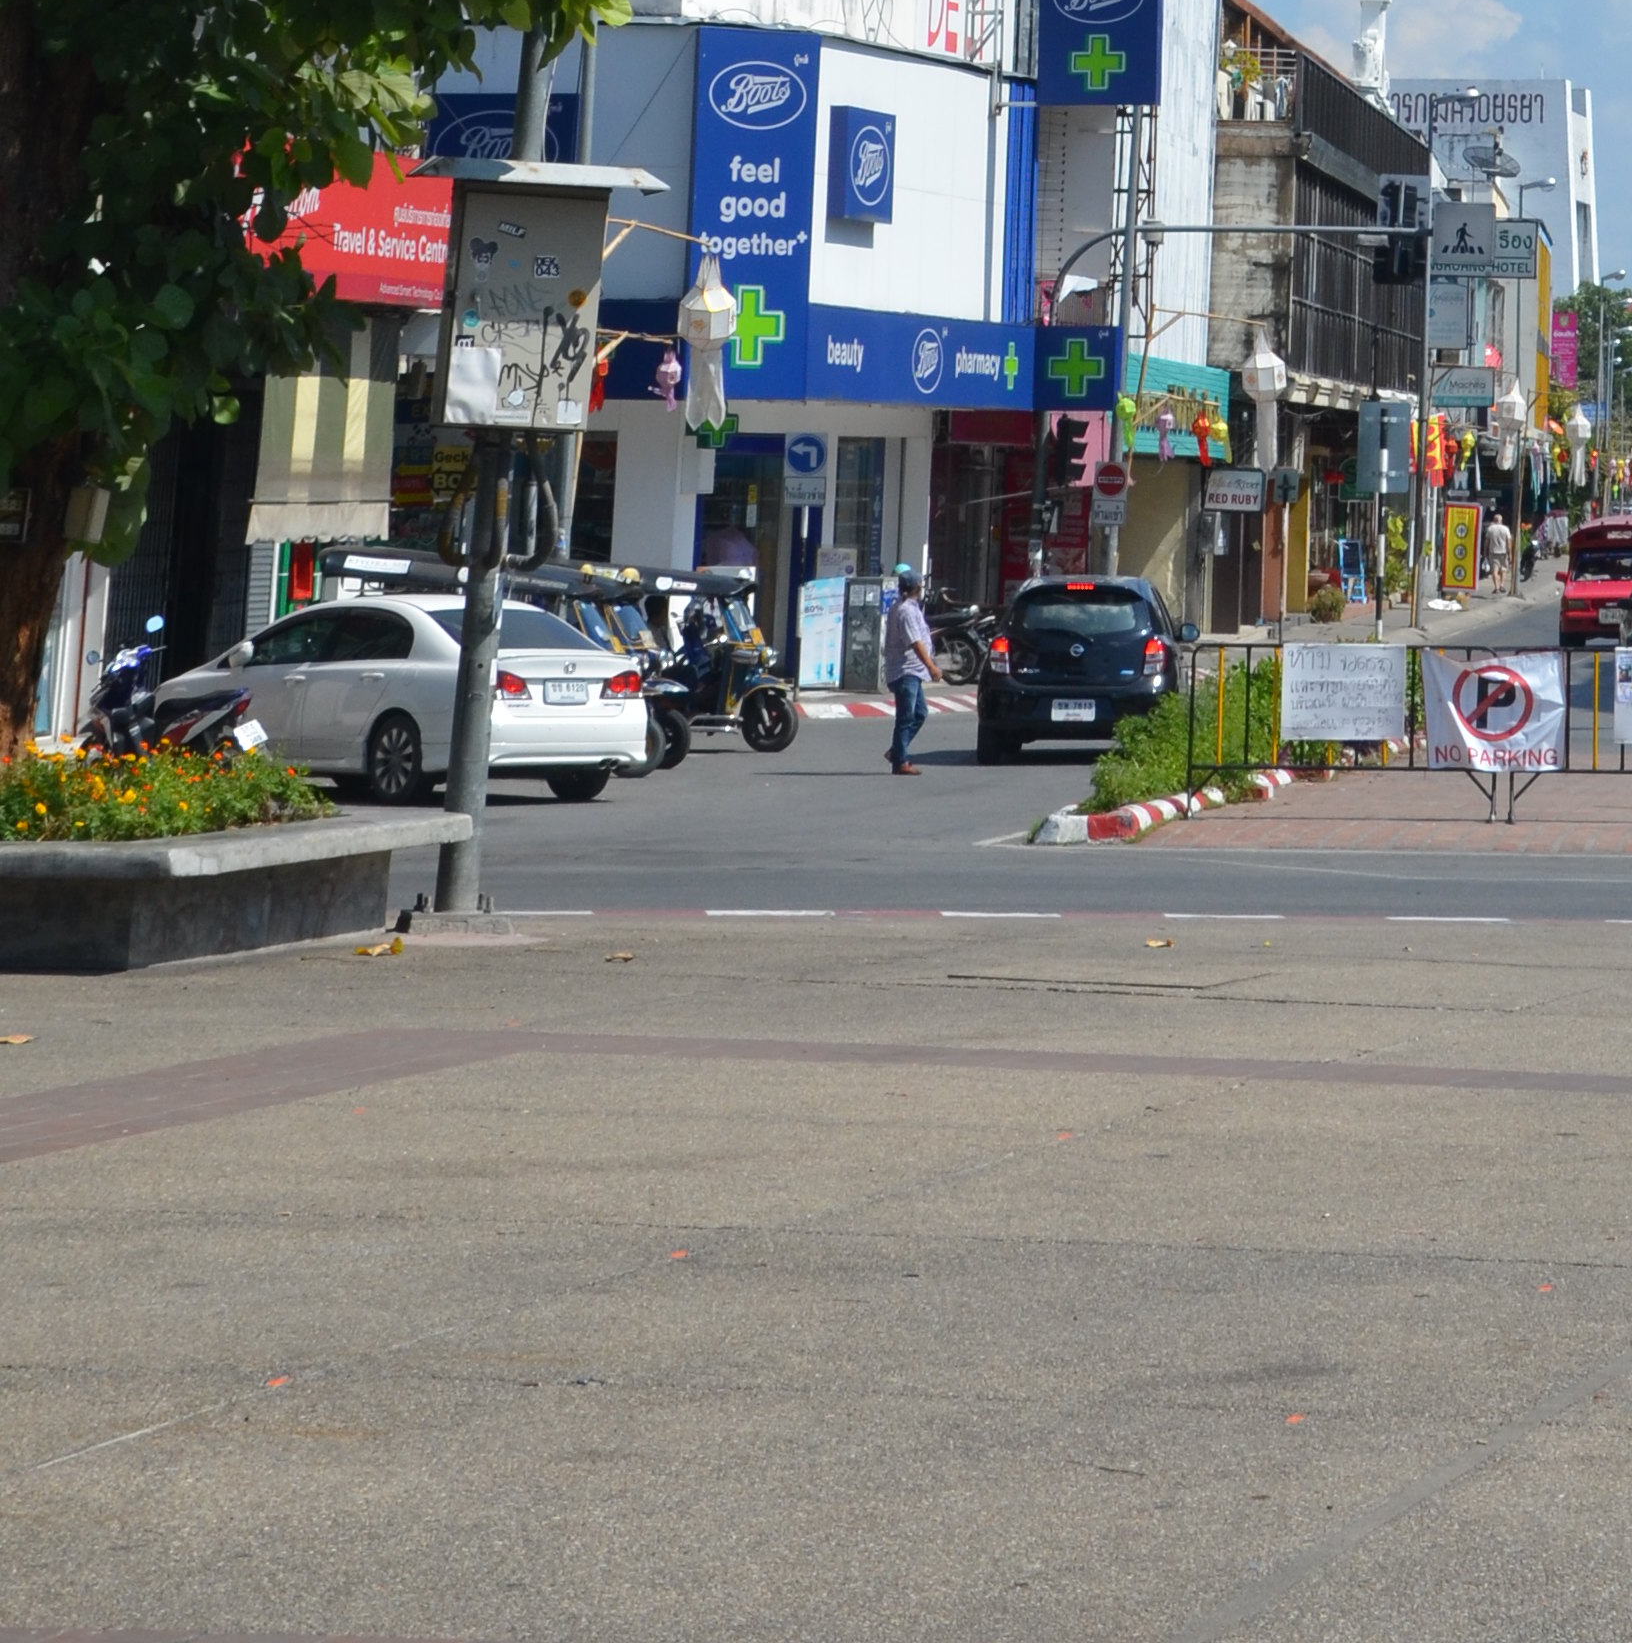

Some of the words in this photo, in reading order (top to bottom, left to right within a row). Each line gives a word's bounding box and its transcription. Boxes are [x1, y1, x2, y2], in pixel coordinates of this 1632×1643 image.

[720, 73, 791, 115] Boots
[729, 155, 781, 184] feel
[719, 191, 787, 223] good
[333, 222, 367, 256] Travel
[367, 226, 376, 256] &
[377, 229, 416, 261] Service
[418, 234, 448, 265] Centr
[1492, 262, 1532, 274] HOTEL
[827, 335, 864, 373] beauty
[955, 350, 1001, 382] pharmacy
[434, 451, 469, 464] Geck
[1208, 493, 1228, 504] RED
[1231, 494, 1259, 505] RUBY
[1434, 744, 1462, 764] NO
[1467, 746, 1558, 766] PARKING
